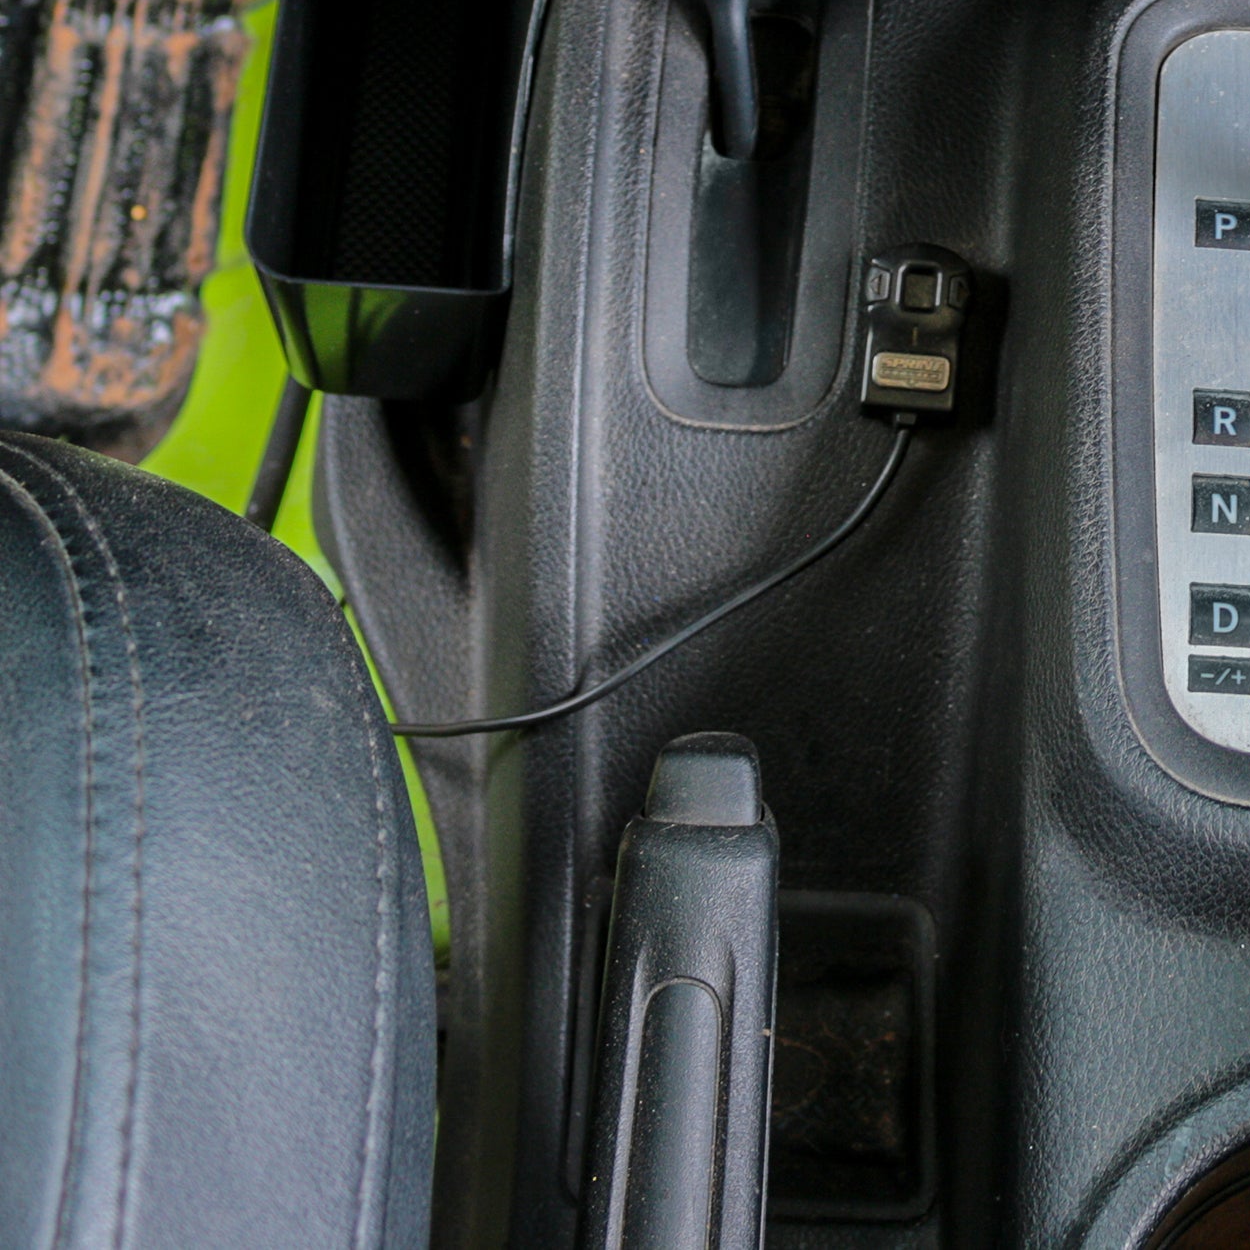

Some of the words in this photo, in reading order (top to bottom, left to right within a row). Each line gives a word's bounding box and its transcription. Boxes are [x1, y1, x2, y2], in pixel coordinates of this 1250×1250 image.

[1215, 213, 1237, 239] P
[1213, 405, 1236, 436] R
[1211, 494, 1237, 524] N
[1213, 602, 1239, 633] D
